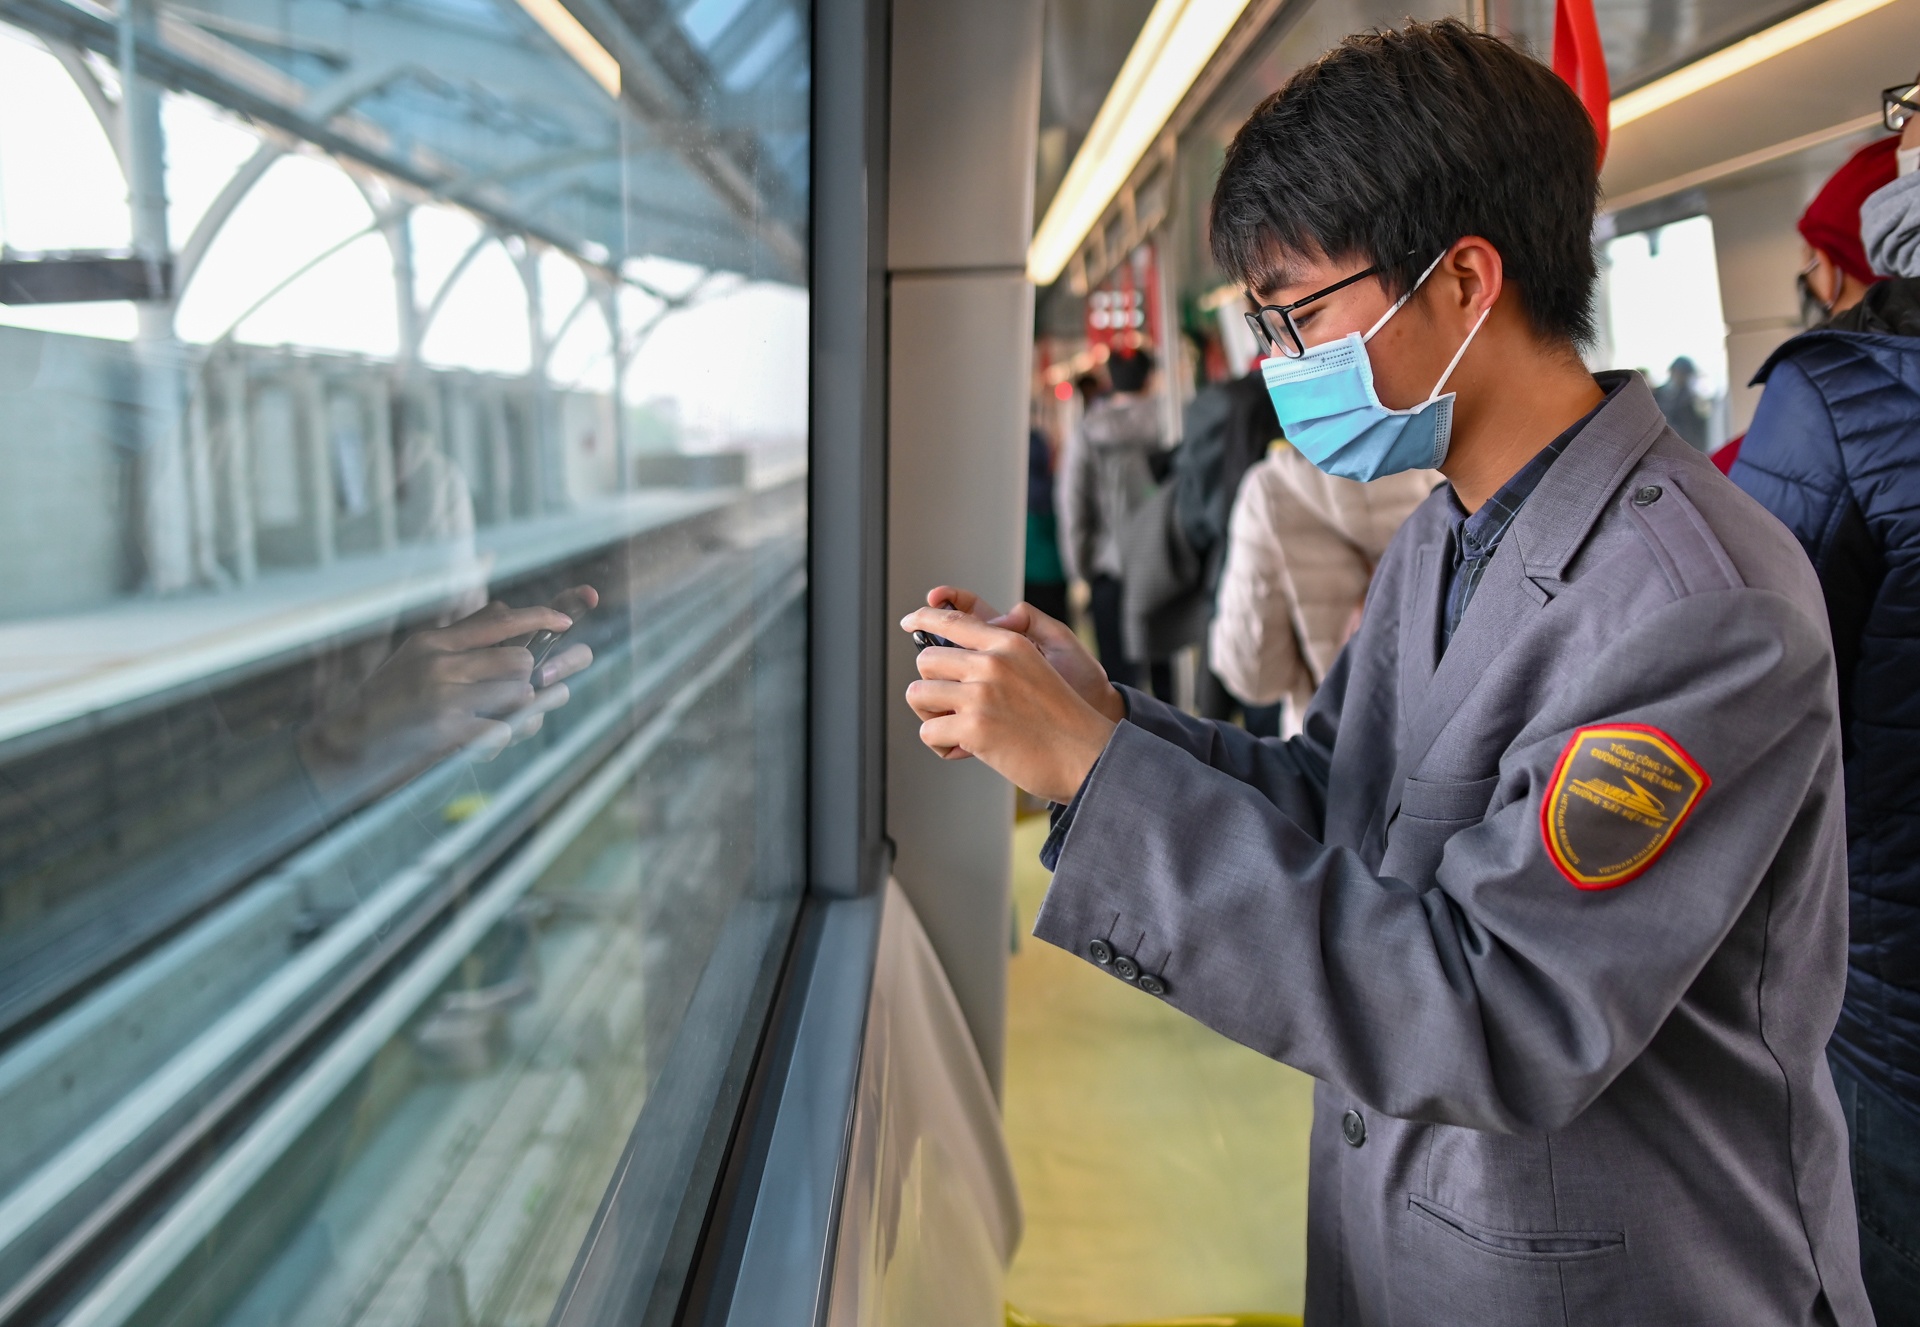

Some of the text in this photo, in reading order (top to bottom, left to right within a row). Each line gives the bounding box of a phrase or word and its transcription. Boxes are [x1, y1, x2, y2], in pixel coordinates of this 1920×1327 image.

[1636, 754, 1661, 771] CÔNG
[1662, 765, 1675, 776] TY
[1622, 761, 1640, 775] SẮT
[1661, 778, 1683, 793] NAM
[1598, 858, 1634, 874] VIETNAM
